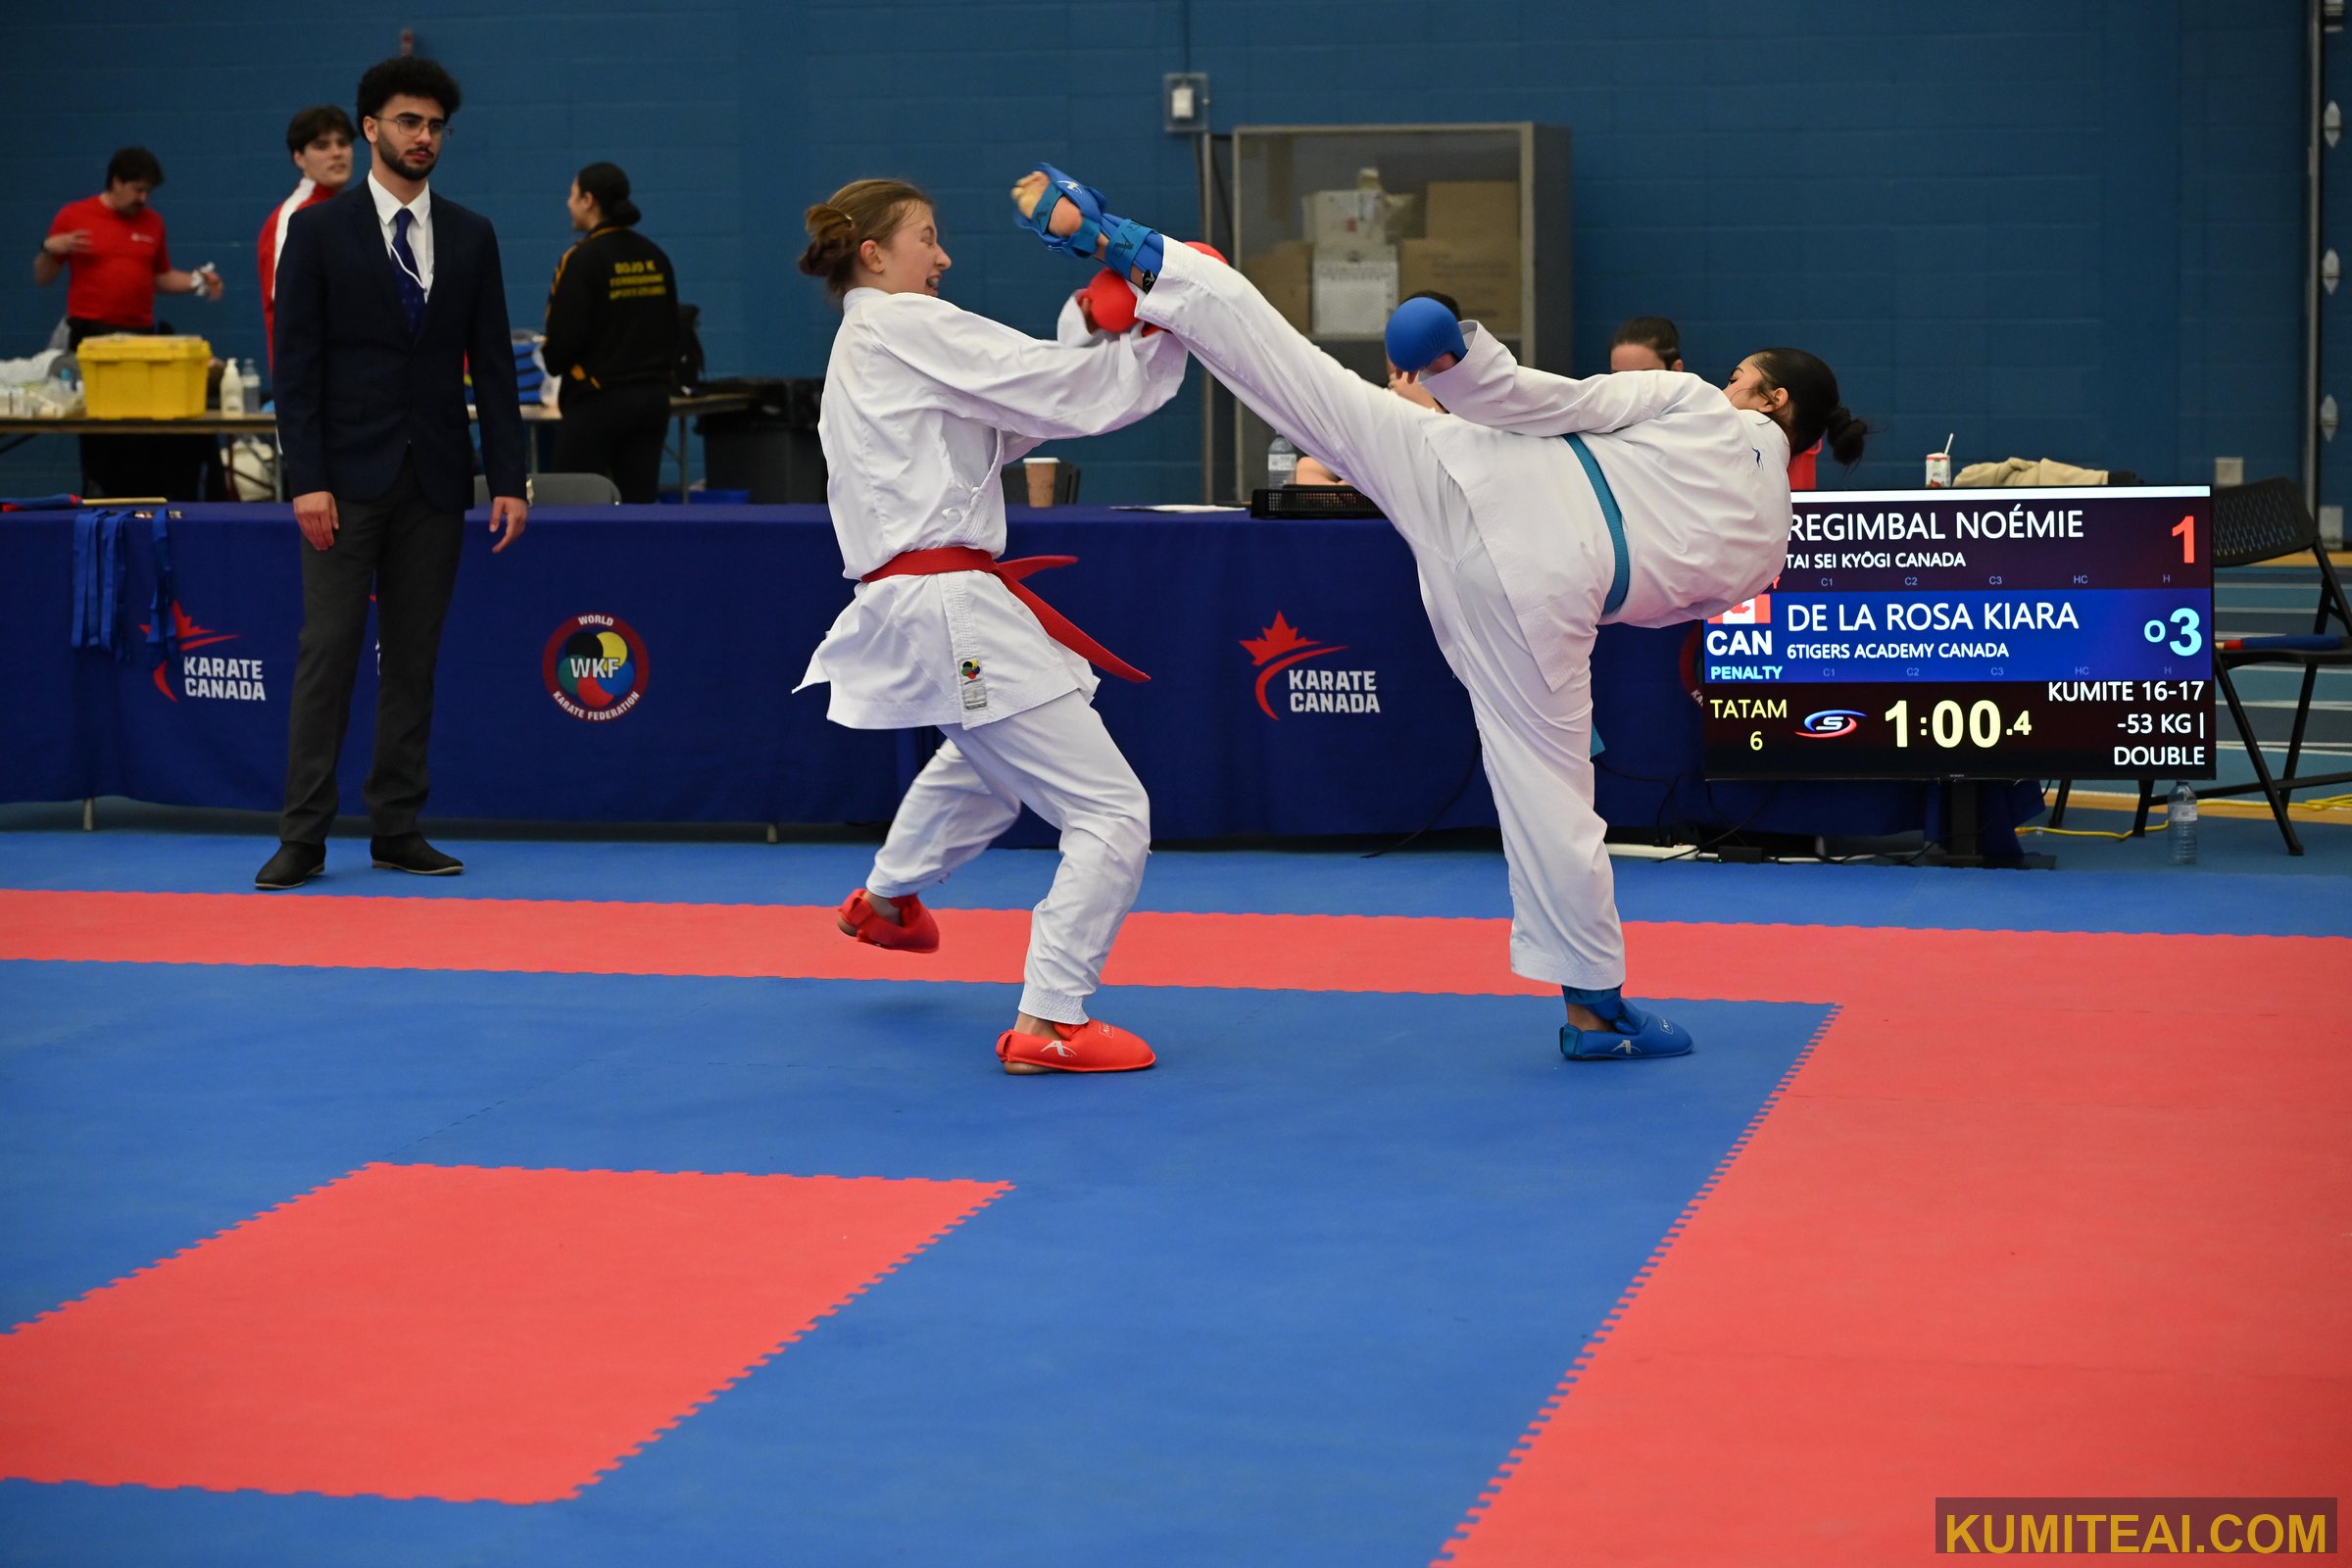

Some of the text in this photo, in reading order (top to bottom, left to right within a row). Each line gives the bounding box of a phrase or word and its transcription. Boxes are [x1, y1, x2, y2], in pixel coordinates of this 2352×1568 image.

[1788, 504, 2083, 542] REGIMBAL NOÉMIE
[2172, 515, 2194, 564] 1
[1786, 551, 1966, 568] TAI SEI KYŌGI CANADA
[1904, 577, 1918, 586] C2
[1988, 575, 2002, 585] C3
[2074, 575, 2087, 584] HC
[2163, 574, 2171, 583] H
[578, 614, 613, 626] WORLD
[1788, 602, 2080, 631] DE LA ROSA KIARA
[1706, 630, 1773, 656] CAN
[1787, 643, 2009, 659] 6TIGERS ACADEMY CANADA
[184, 657, 264, 679] KARATE
[570, 658, 619, 679] WKF
[1710, 666, 1783, 680] PENALTY
[1823, 668, 1836, 677] C1
[1906, 667, 1920, 676] C2
[1990, 666, 2004, 676] C3
[2075, 666, 2089, 675] HC
[185, 677, 266, 701] CANADA
[1289, 669, 1377, 691] KARATE
[2048, 681, 2204, 702] KUMITE 16-17
[552, 690, 641, 721] KARATE FEDERATION
[1290, 692, 1381, 713] CANADA
[1710, 699, 1788, 718] TATAM
[2117, 713, 2152, 734] -53
[2161, 713, 2191, 734] KG
[1749, 731, 1763, 751] 6
[2114, 746, 2205, 765] DOUBLE
